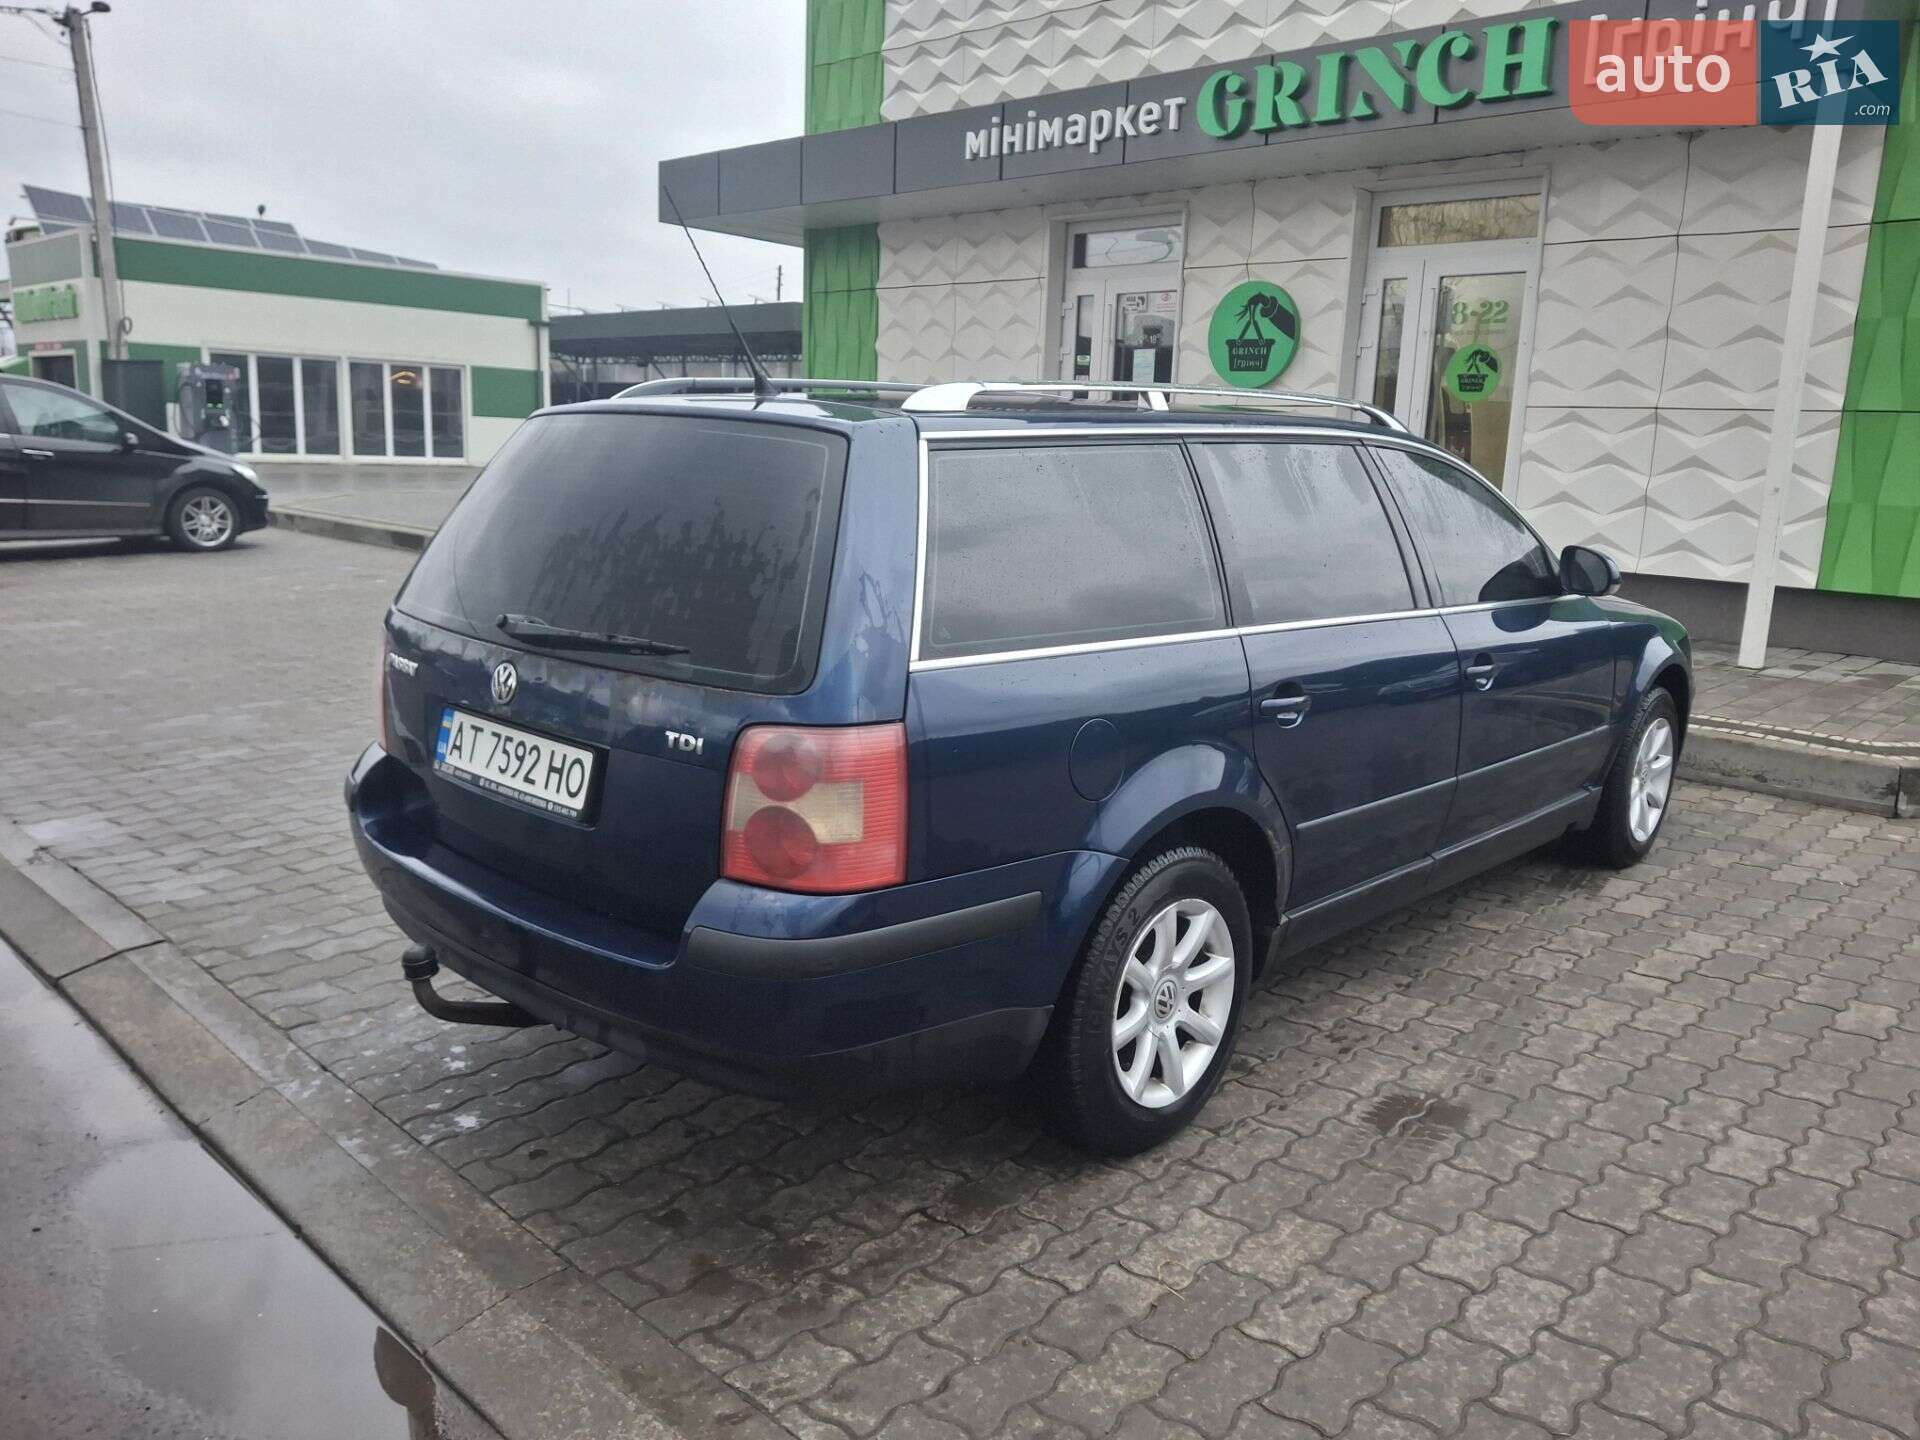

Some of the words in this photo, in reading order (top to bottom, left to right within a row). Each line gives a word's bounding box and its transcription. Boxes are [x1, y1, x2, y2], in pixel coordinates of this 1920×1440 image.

[1196, 17, 1559, 137] GRINCH
[965, 97, 1187, 159] мінімаркет
[1452, 300, 1509, 325] 8-22
[1232, 346, 1267, 355] GRINCH
[450, 721, 484, 763] AT
[485, 731, 542, 786] 7592
[544, 749, 586, 799] HO
[665, 730, 704, 755] TDI
